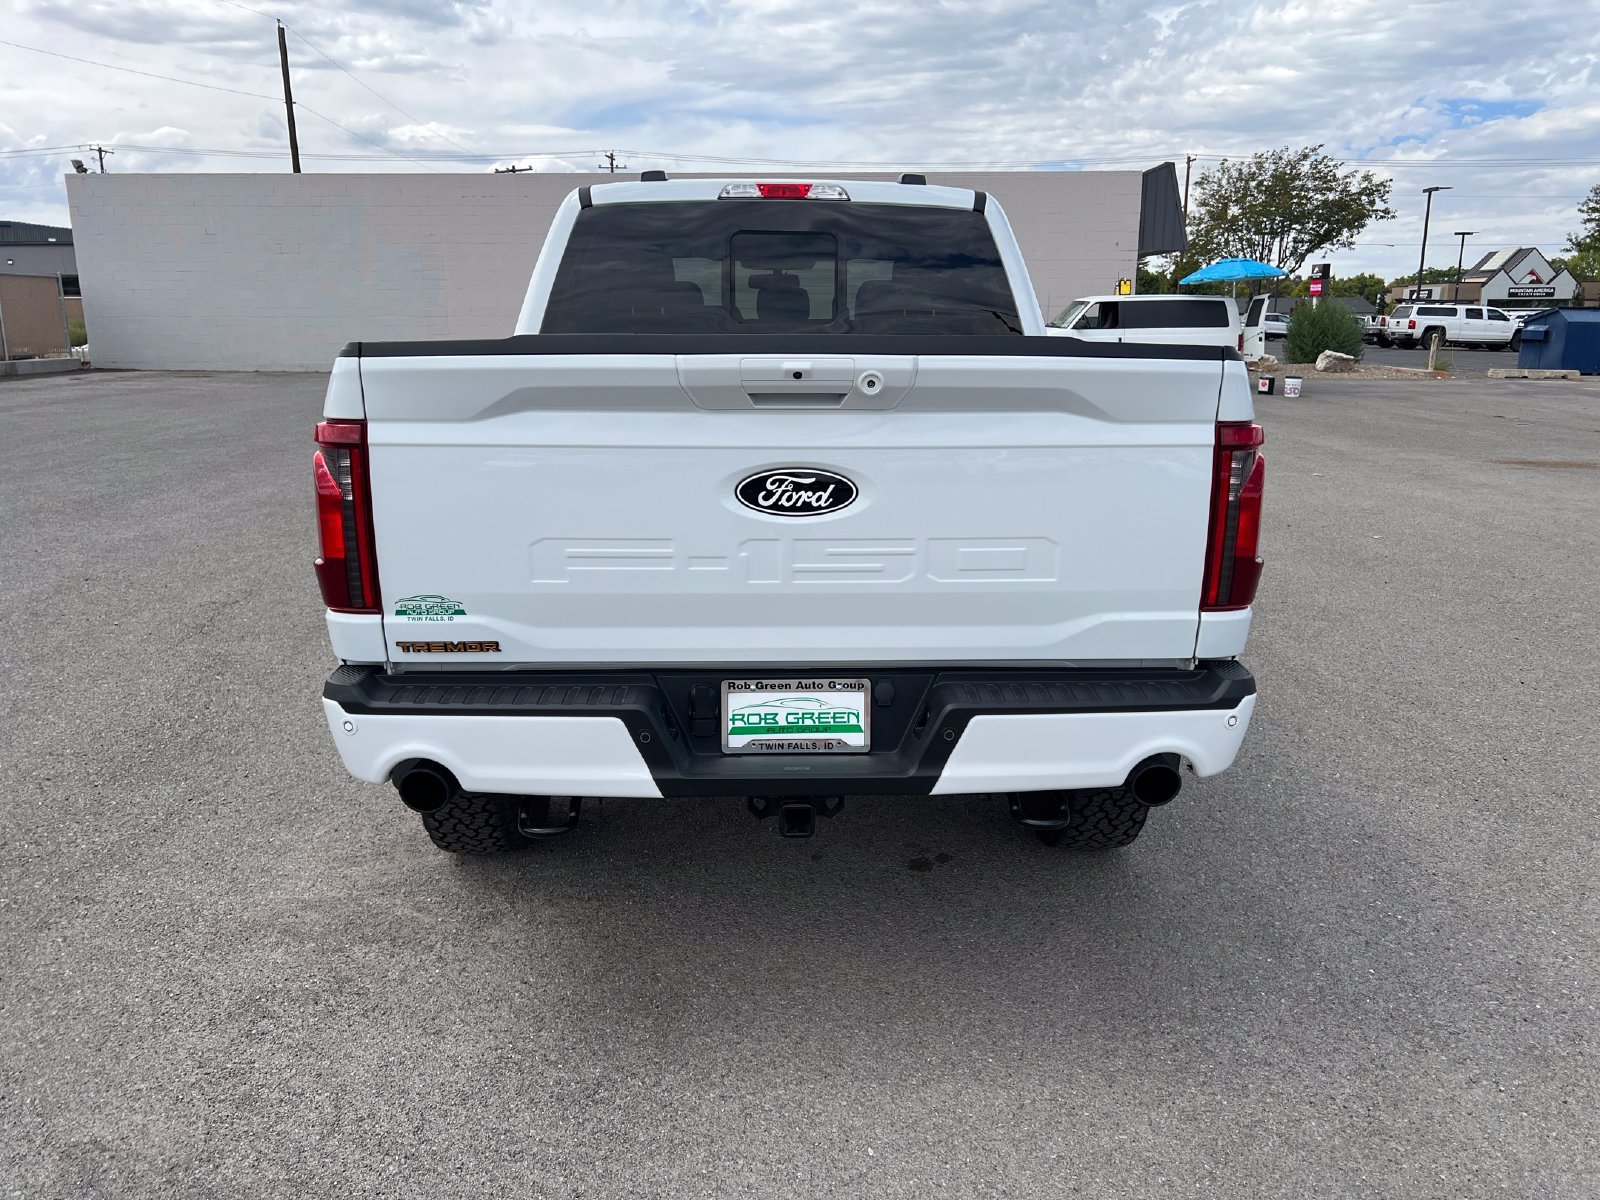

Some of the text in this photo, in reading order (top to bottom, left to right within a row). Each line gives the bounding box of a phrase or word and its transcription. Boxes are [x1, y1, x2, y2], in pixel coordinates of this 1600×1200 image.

[758, 475, 835, 508] Ford
[530, 538, 1060, 583] F-150
[396, 641, 502, 652] TREMOR
[727, 681, 750, 690] Rob
[755, 681, 792, 690] Green
[796, 681, 824, 690] Auto
[730, 711, 860, 725] ROB GREEN
[823, 742, 834, 750] ID
